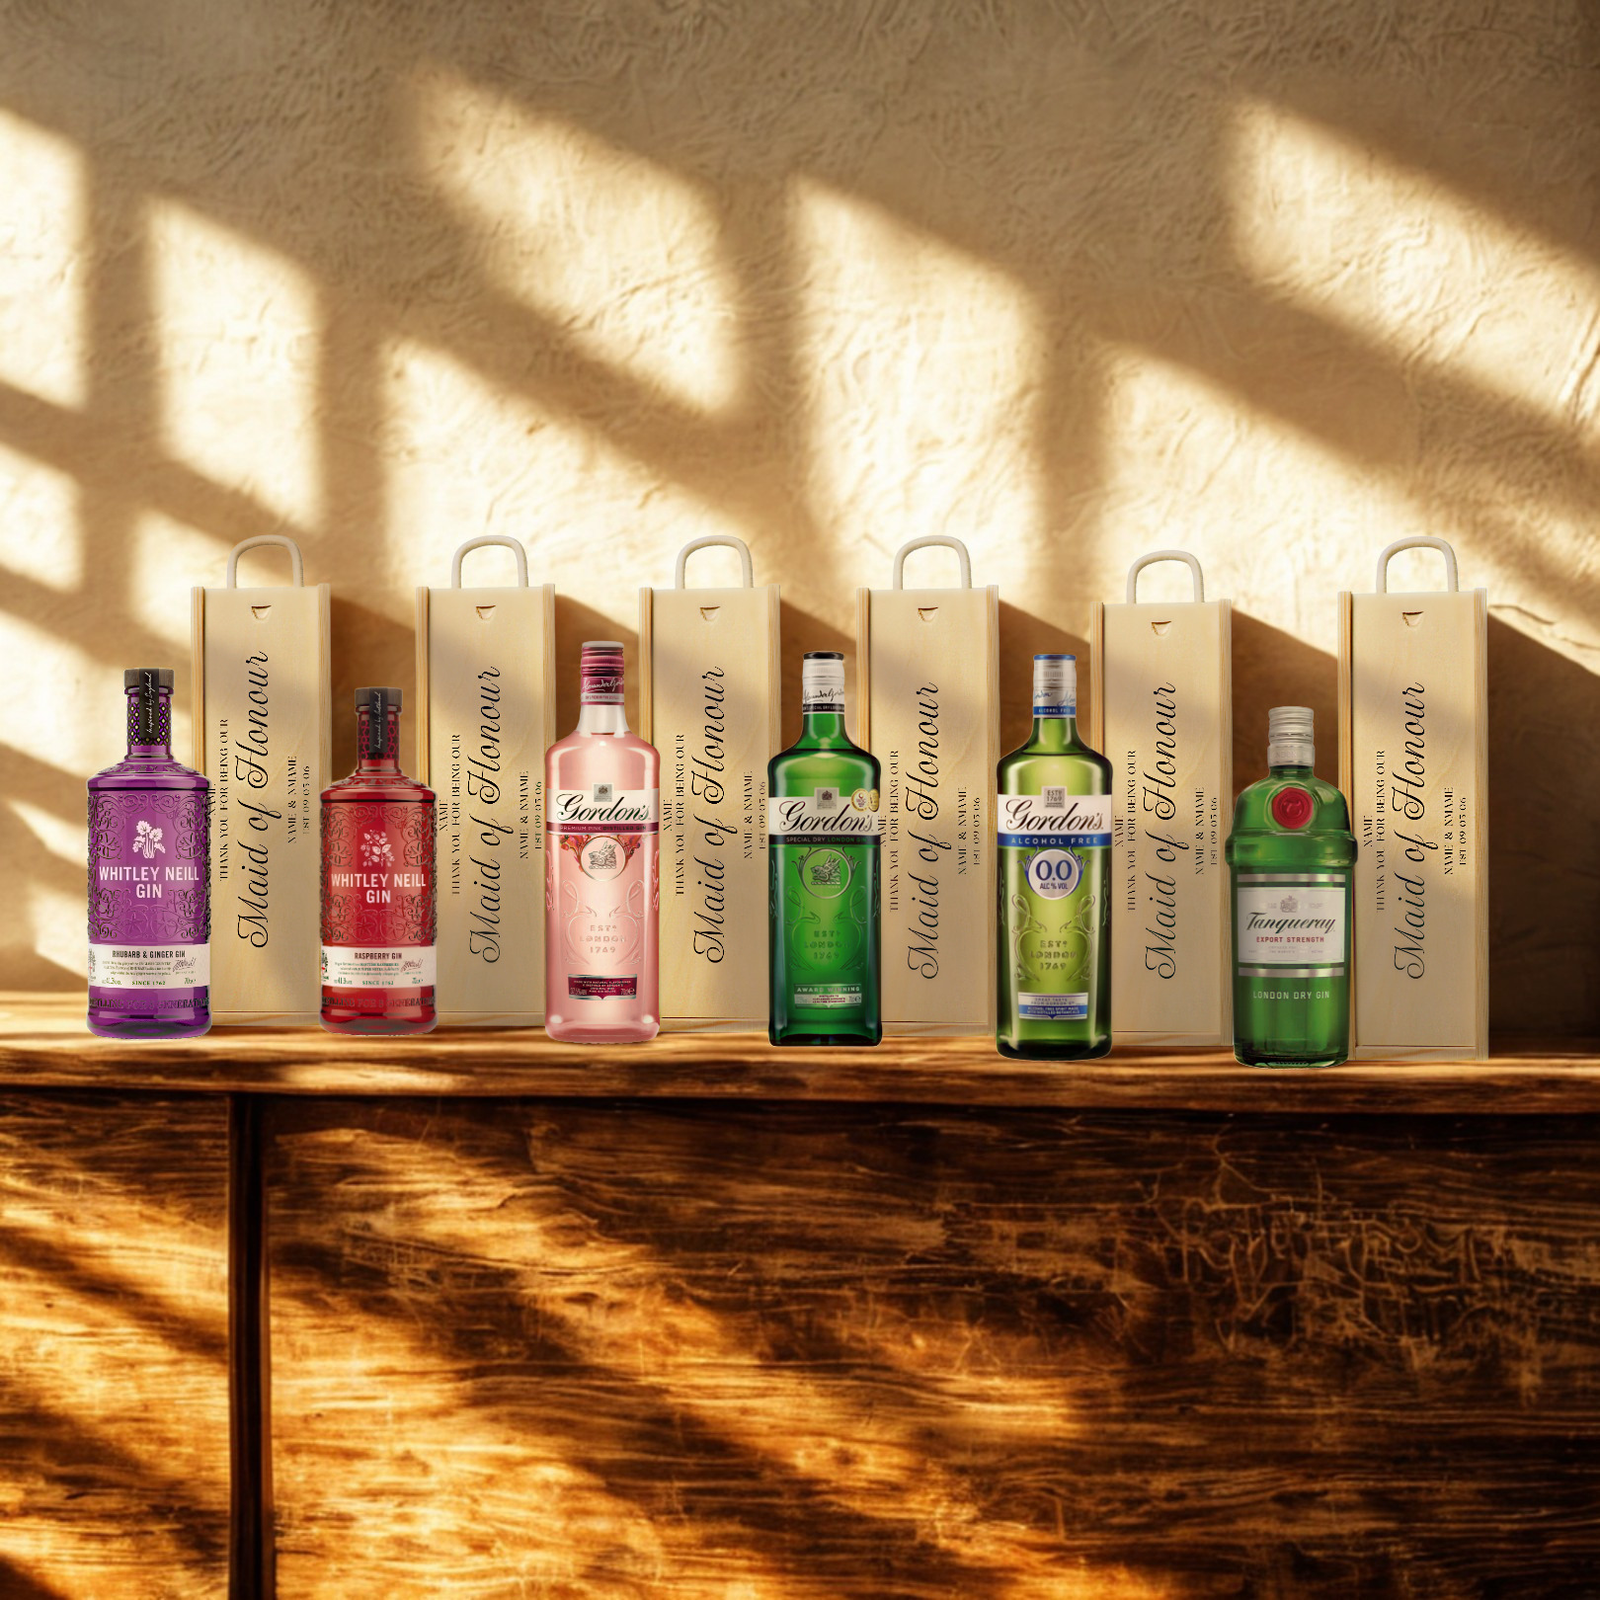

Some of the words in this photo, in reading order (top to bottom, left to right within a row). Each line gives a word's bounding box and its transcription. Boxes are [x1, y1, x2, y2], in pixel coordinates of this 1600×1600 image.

[220, 719, 229, 744] OUR
[235, 651, 269, 790] Honour
[467, 666, 501, 804] Honour
[691, 666, 725, 804] Honour
[452, 734, 461, 759] OUR
[676, 734, 685, 759] OUR
[905, 682, 939, 820] Honour
[1142, 682, 1176, 820] Honour
[1391, 682, 1425, 820] Honour
[220, 748, 229, 782] BEING
[890, 750, 899, 775] OUR
[1127, 750, 1136, 775] OUR
[1376, 750, 1385, 775] OUR
[452, 763, 461, 797] BEING
[676, 763, 685, 797] BEING
[220, 787, 229, 811] FOR
[556, 792, 650, 822] Gordon's
[890, 779, 899, 813] BEING
[1127, 779, 1136, 813] BEING
[1376, 779, 1385, 813] BEING
[220, 816, 229, 838] YOU
[237, 798, 281, 831] of
[288, 814, 296, 844] NAME
[452, 802, 461, 826] FOR
[676, 802, 685, 826] FOR
[779, 801, 873, 832] Gordon's
[1006, 799, 1103, 831] Gordon's
[452, 831, 461, 853] YOU
[469, 813, 513, 846] of
[520, 829, 528, 859] NAME
[676, 831, 685, 853] YOU
[693, 813, 737, 846] of
[744, 829, 752, 859] NAME
[890, 818, 899, 842] FOR
[1127, 818, 1136, 842] FOR
[1376, 818, 1385, 842] FOR
[890, 847, 899, 869] YOU
[907, 829, 951, 862] of
[958, 845, 966, 875] NAME
[1127, 847, 1136, 869] YOU
[1144, 829, 1188, 862] of
[1195, 845, 1203, 875] NAME
[1376, 847, 1385, 869] YOU
[1393, 829, 1437, 862] of
[1444, 845, 1452, 875] NAME
[100, 867, 159, 881] WHITLEY
[166, 867, 199, 881] NEILL
[220, 844, 229, 881] THANK
[452, 859, 461, 896] THANK
[676, 859, 685, 896] THANK
[1035, 860, 1072, 881] 0.0
[136, 884, 162, 898] GIN
[237, 840, 269, 948] Maid
[332, 874, 389, 888] WHITLEY
[394, 874, 426, 887] NEILL
[890, 875, 899, 912] THANK
[1127, 875, 1136, 912] THANK
[1376, 875, 1385, 912] THANK
[366, 890, 391, 903] GIN
[469, 855, 501, 963] Maid
[693, 855, 725, 963] Maid
[907, 871, 939, 979] Maid
[1144, 871, 1176, 979] Maid
[1246, 912, 1336, 934] Tanqueray
[1393, 871, 1425, 979] Maid
[1253, 991, 1289, 1000] LONDON
[1293, 991, 1312, 999] DRY
